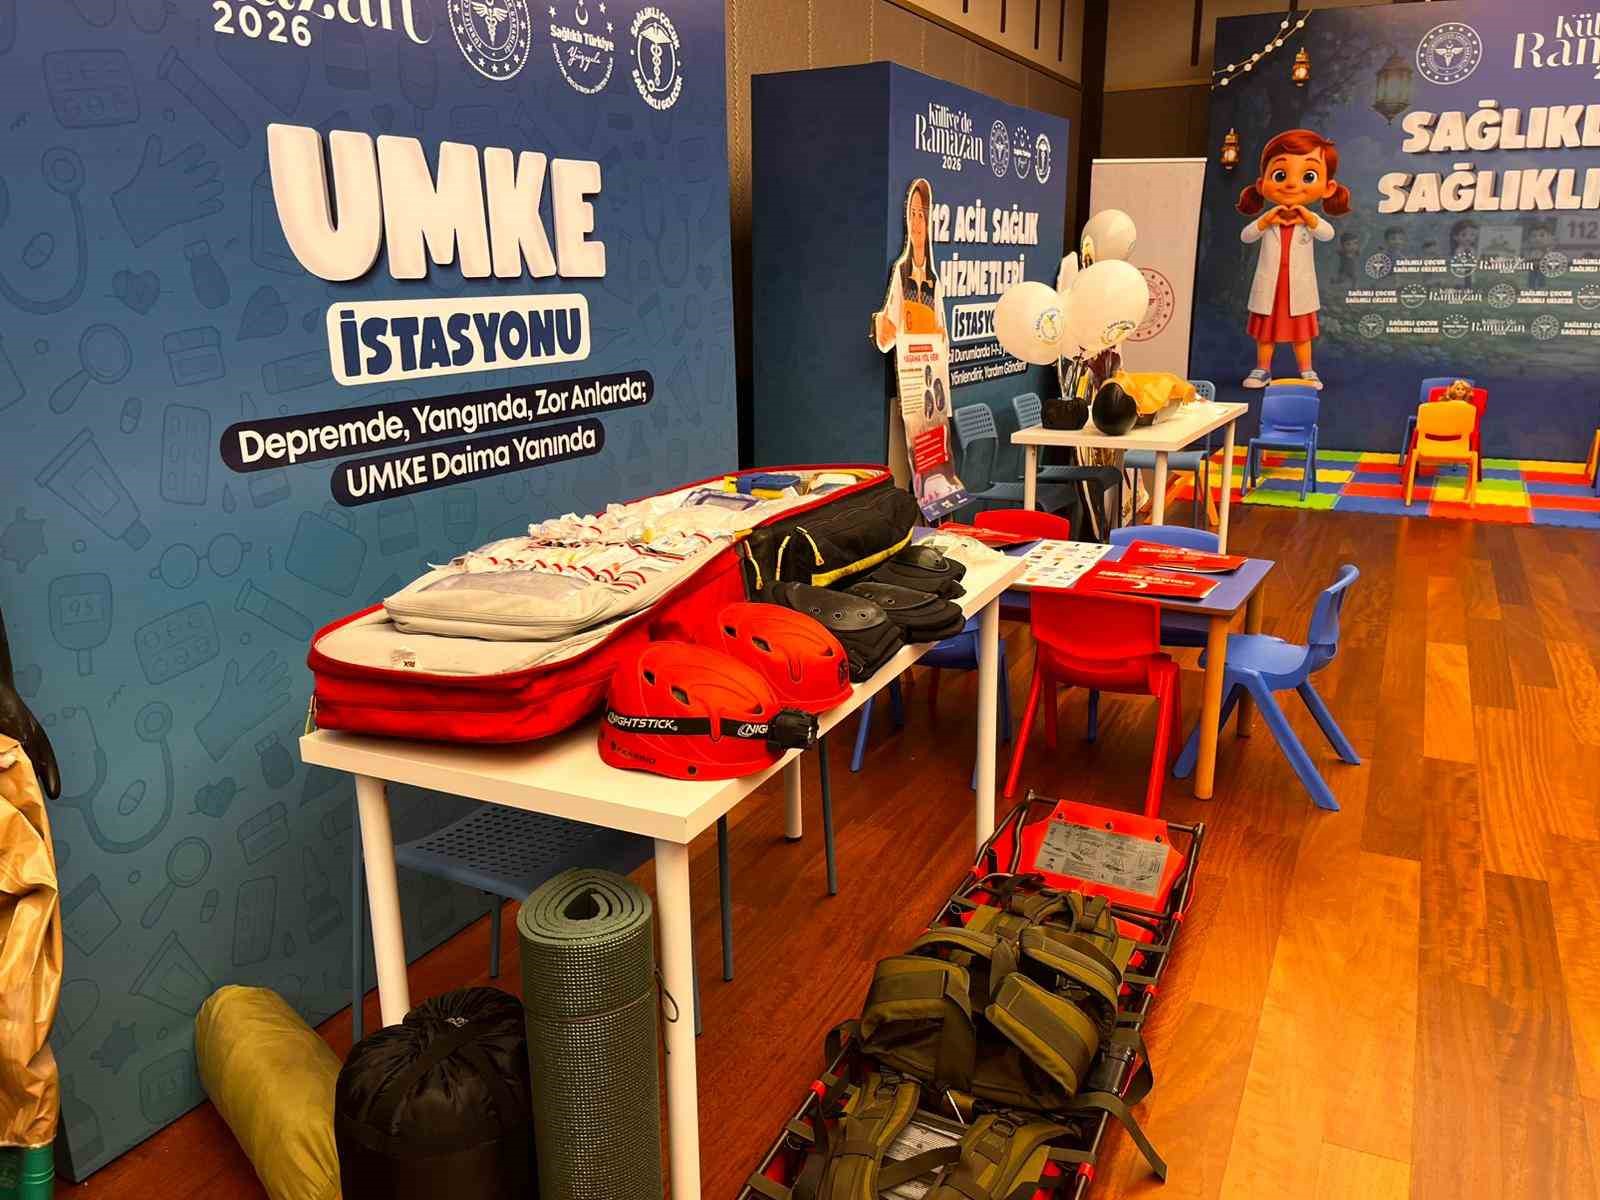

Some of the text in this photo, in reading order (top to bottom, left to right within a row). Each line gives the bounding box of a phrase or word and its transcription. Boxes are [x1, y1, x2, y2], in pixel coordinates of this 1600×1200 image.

[212, 1, 313, 47] 2026
[583, 33, 614, 52] Türkiye
[915, 113, 985, 166] Ramazan
[942, 155, 962, 171] 2026
[267, 123, 606, 281] UMKE
[954, 198, 988, 243] ACİL
[992, 204, 1039, 245] SAĞLIK
[1568, 220, 1599, 240] 112
[339, 307, 582, 377] İSTASYONU
[238, 378, 647, 464] Depremde, Yangında, Zor Anlarda;
[346, 426, 596, 497] UMKE Daima Yanında
